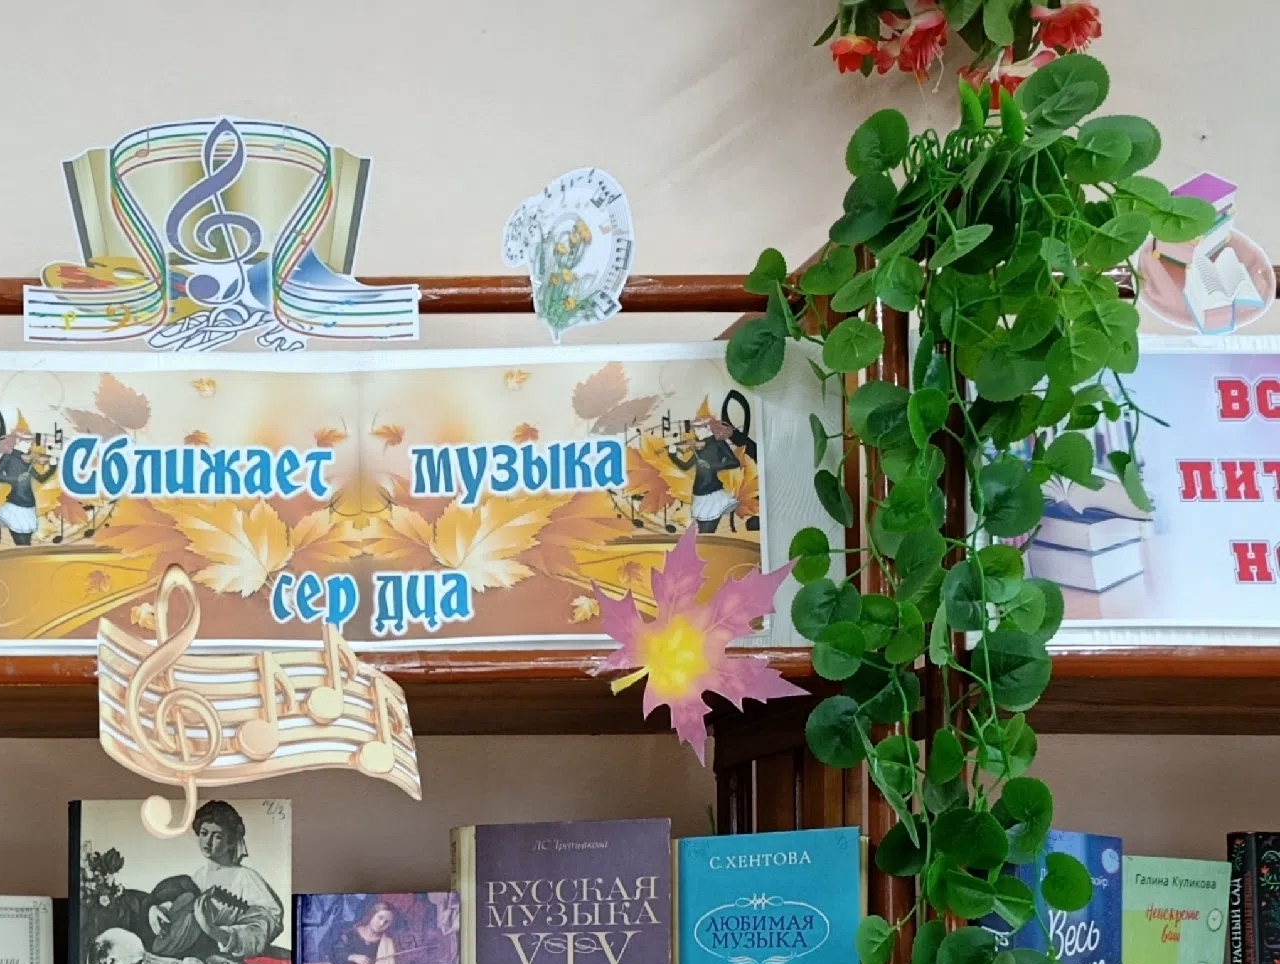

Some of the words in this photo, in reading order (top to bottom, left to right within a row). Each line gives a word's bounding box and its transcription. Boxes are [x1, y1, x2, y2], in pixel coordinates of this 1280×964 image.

[61, 437, 333, 498] Сближает
[412, 439, 626, 505] музыка
[725, 851, 812, 869] ХЕНТОВА
[486, 875, 660, 904] РУССКАЯ
[1135, 873, 1169, 887] Галина
[1172, 876, 1217, 890] Куликова
[1229, 878, 1242, 905] САД
[486, 900, 662, 928] МУЗЫКА
[705, 915, 815, 932] ЛЮБИМАЯ
[711, 931, 808, 949] МУЗЫКА
